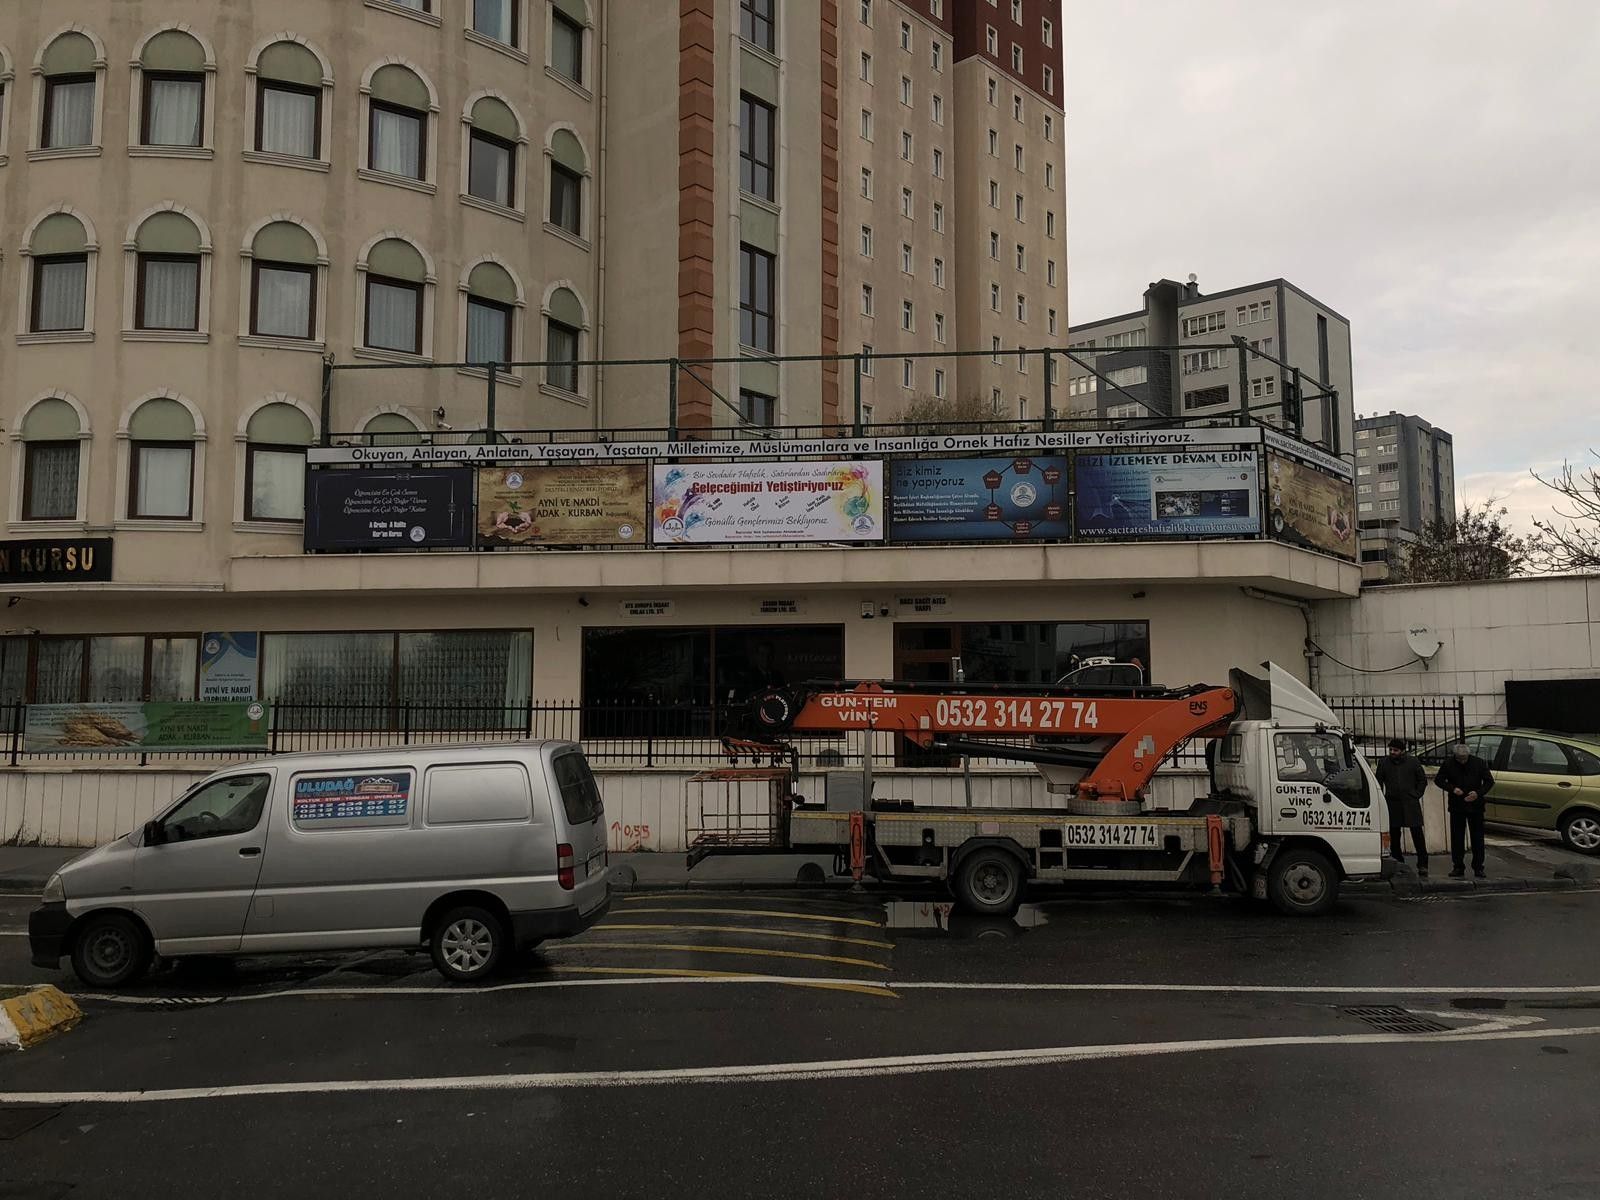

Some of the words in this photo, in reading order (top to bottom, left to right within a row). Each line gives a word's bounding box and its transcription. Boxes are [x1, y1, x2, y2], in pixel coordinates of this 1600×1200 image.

[352, 448, 408, 462] Okuyan,
[412, 447, 470, 461] Anlayan,
[476, 446, 533, 460] Anlatan,
[538, 445, 599, 459] Yaşayan,
[604, 444, 665, 458] Yaşatan,
[667, 441, 745, 456] Milletimize,
[750, 440, 849, 453] Müslümanlara
[853, 442, 870, 452] ve
[993, 435, 1031, 447] Hafız
[1035, 432, 1092, 446] Nesiller
[1096, 431, 1195, 447] Yetiştiriyoruz.
[1109, 454, 1167, 466] İZLEMEYE
[1173, 454, 1216, 464] DEVAM
[1221, 453, 1253, 463] EDİN
[915, 465, 942, 476] kimiz
[767, 480, 845, 494] Yetiştiriyoruz
[911, 478, 965, 490] yapıyoruz
[538, 498, 558, 507] AYNİ
[560, 498, 571, 507] VE
[573, 497, 600, 507] NAKDİ
[536, 509, 560, 518] ADAK
[568, 508, 603, 518] KURBAN
[20, 546, 94, 572] KURSU
[204, 685, 220, 695] AYNİ
[221, 686, 230, 695] VE
[231, 685, 251, 695] NAKDİ
[820, 694, 897, 708] GÜN-TEM
[1190, 701, 1208, 710] ENS
[838, 708, 879, 724] VİNÇ
[936, 699, 987, 727] 0532
[994, 700, 1033, 728] 314
[1039, 701, 1065, 728] 27
[1071, 701, 1099, 729] 74
[297, 778, 354, 792] ULUDAĞ
[1275, 784, 1321, 795] GÜN-TEM
[1288, 796, 1313, 808] VİNÇ
[1302, 811, 1325, 826] 0532
[1327, 811, 1344, 826] 314
[1346, 811, 1357, 826] 27
[1360, 811, 1371, 827] 74
[1067, 824, 1096, 845] 0532
[1099, 825, 1120, 845] 314
[1123, 825, 1137, 845] 27
[1141, 825, 1155, 845] 74
